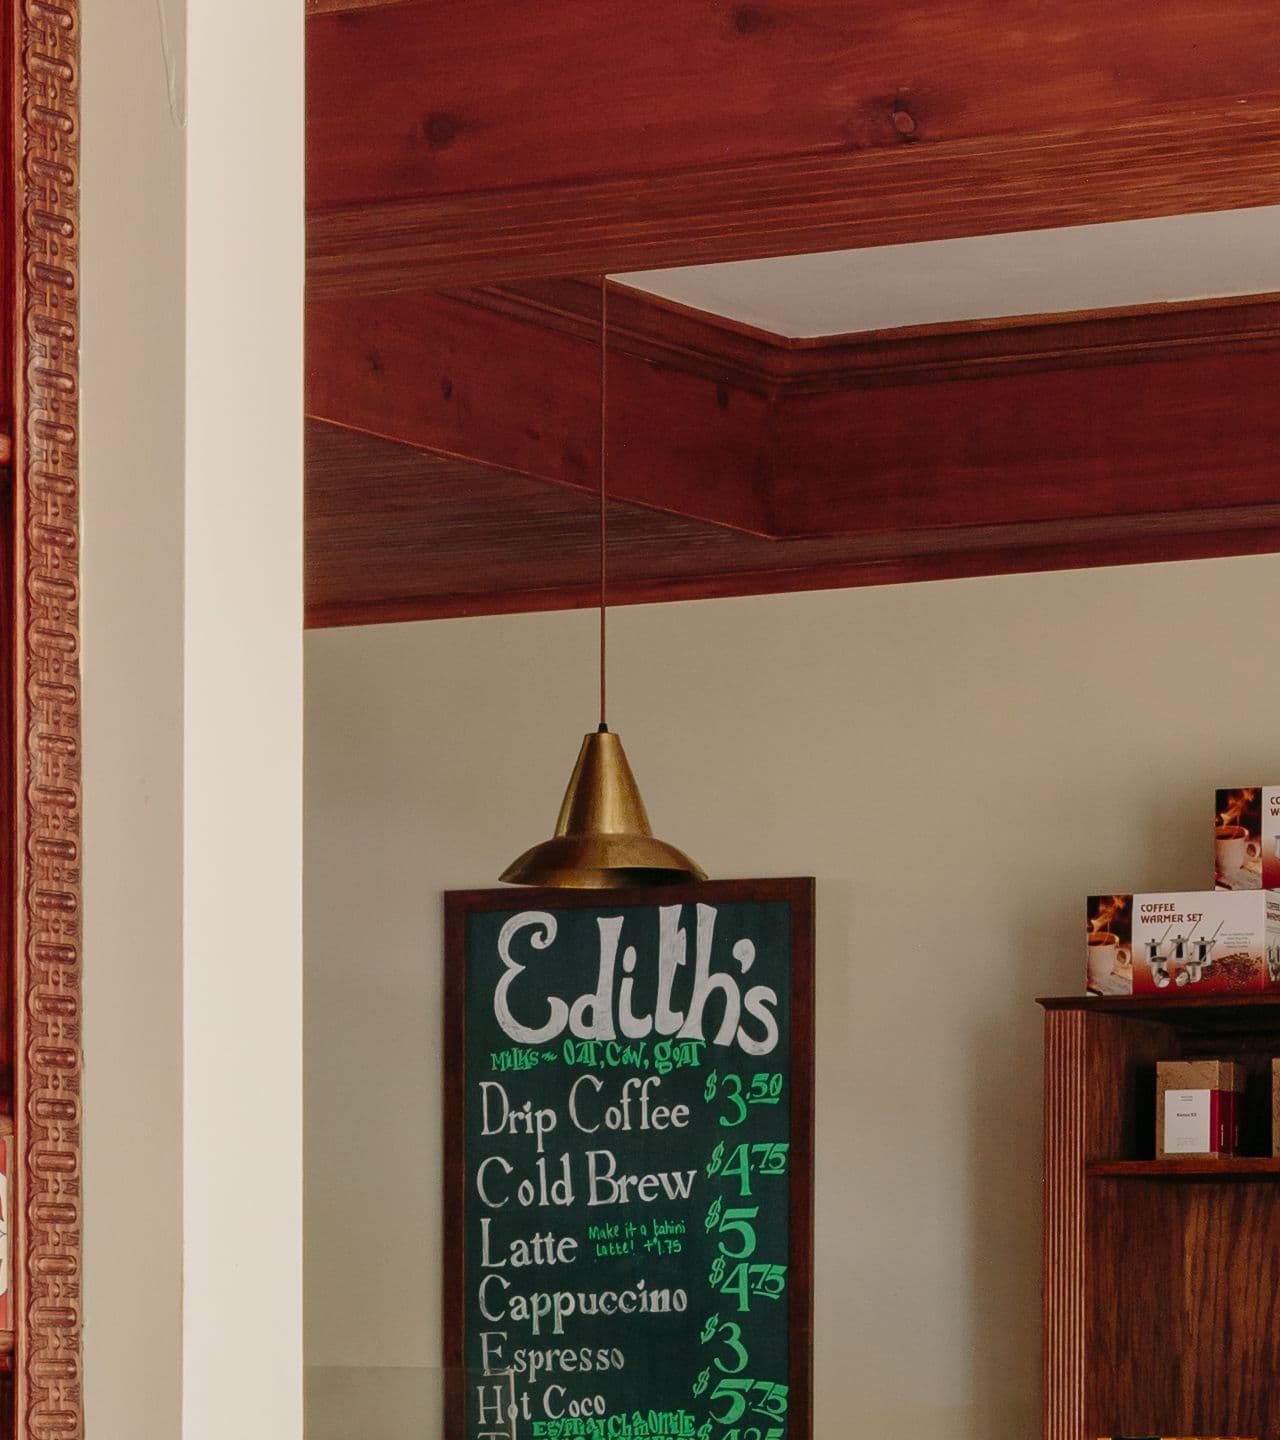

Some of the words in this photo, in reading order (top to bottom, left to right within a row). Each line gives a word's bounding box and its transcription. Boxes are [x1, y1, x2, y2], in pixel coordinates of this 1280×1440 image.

[1140, 903, 1175, 912] COFFEE
[1140, 914, 1184, 924] WARMER
[1187, 913, 1203, 922] SET
[494, 903, 779, 1056] Edith's
[479, 1080, 557, 1153] Drip
[569, 1074, 690, 1134] Coffee
[704, 1068, 783, 1127] $3.50
[476, 1152, 576, 1208] Cold
[585, 1150, 698, 1206] Brew
[706, 1140, 790, 1197] $4.75
[479, 1217, 578, 1267] Latte
[704, 1195, 760, 1260] $5
[588, 1222, 620, 1240] Make
[625, 1221, 637, 1238] it
[640, 1225, 647, 1237] a
[653, 1218, 686, 1238] tahini
[596, 1239, 636, 1257] Latte!
[478, 1274, 689, 1336] Cappuccino
[708, 1255, 788, 1312] $4.75
[479, 1331, 626, 1383] Espresso
[701, 1312, 750, 1374] $3
[476, 1385, 532, 1425] Hot
[543, 1384, 607, 1421] Coco
[693, 1366, 789, 1425] $5.75
